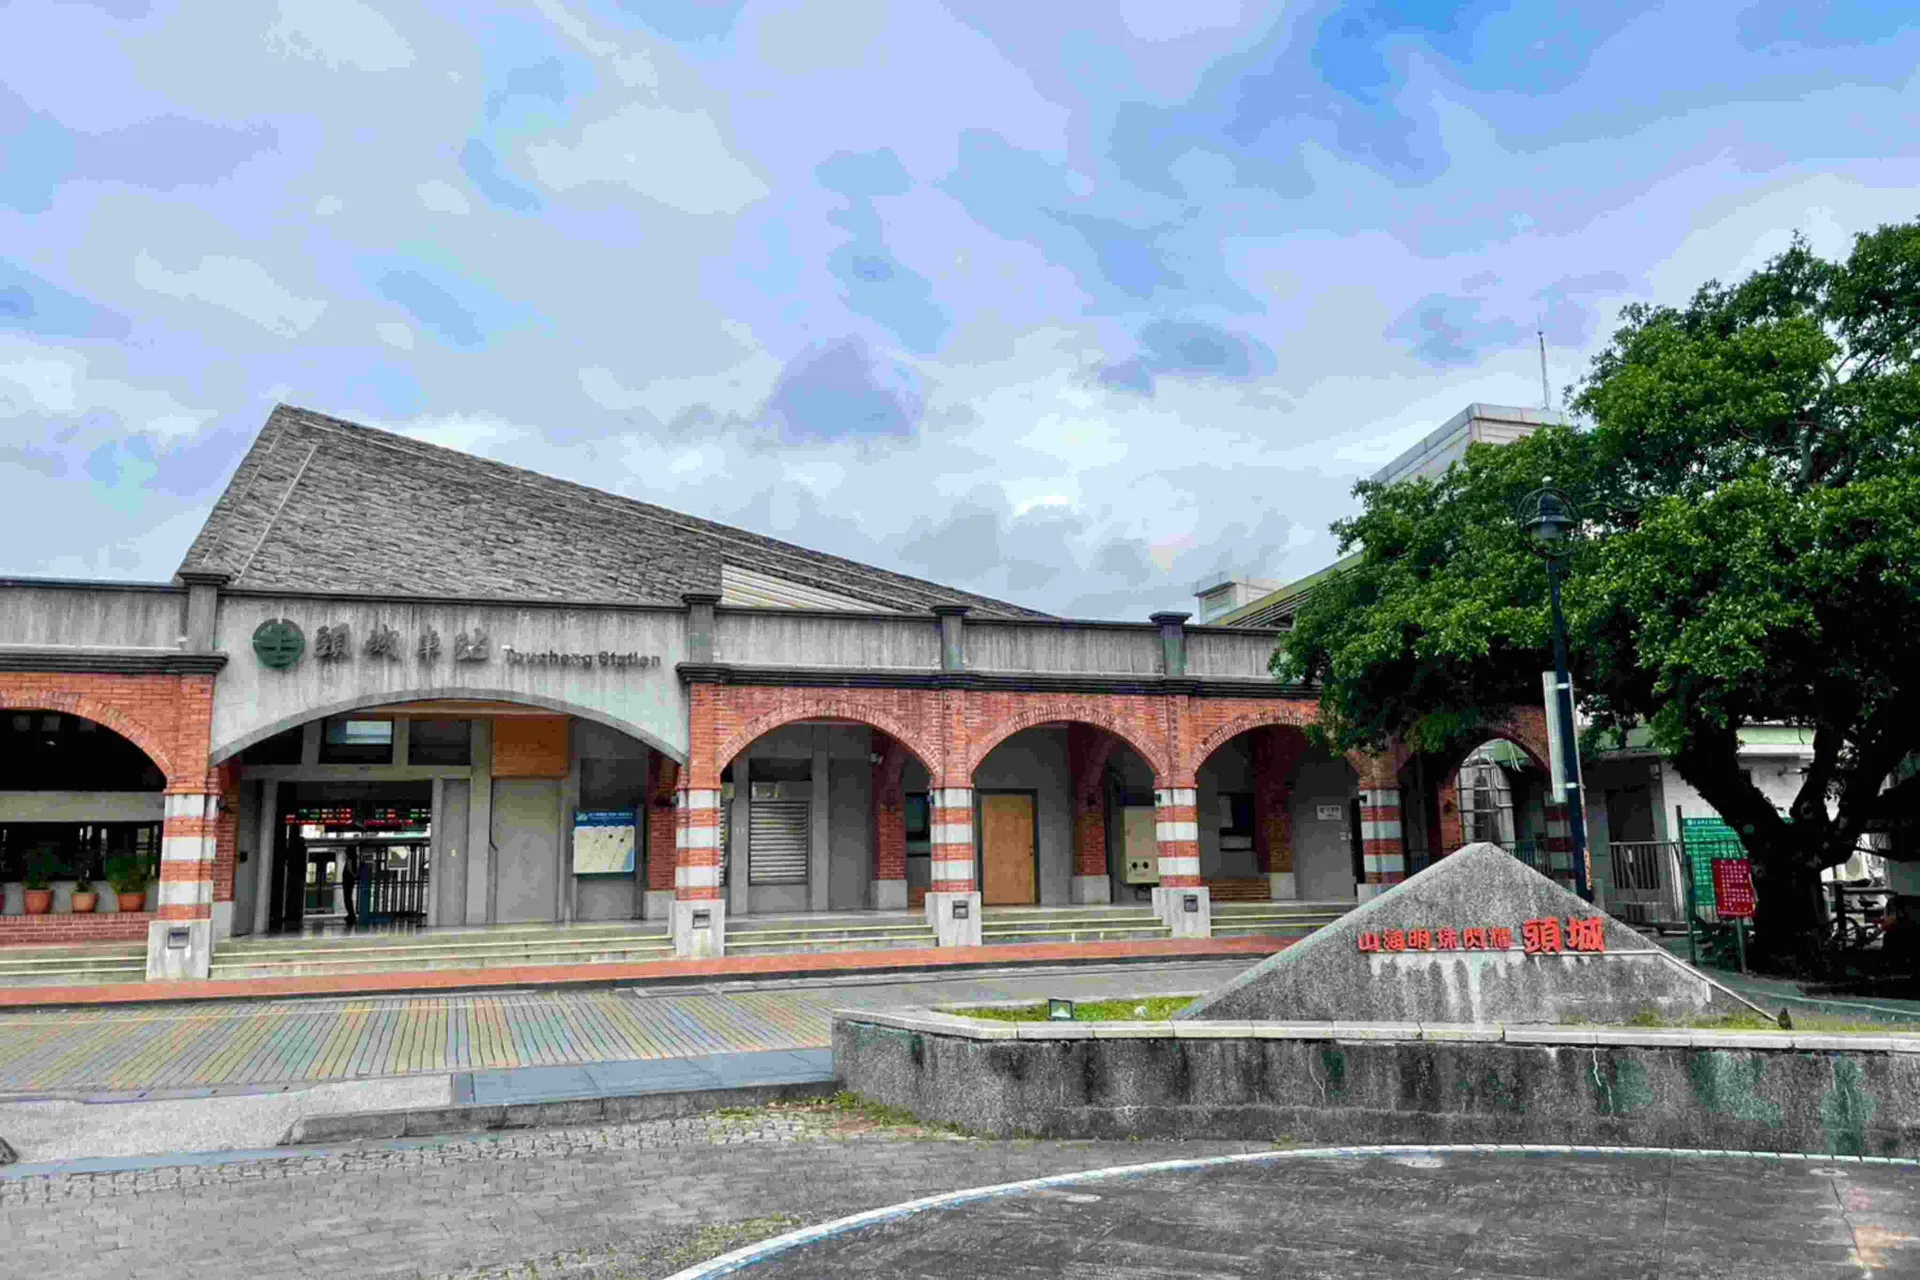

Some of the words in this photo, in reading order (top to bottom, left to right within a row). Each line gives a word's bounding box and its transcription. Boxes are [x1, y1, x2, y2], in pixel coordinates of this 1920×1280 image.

[313, 622, 489, 662] 頭城車站
[504, 648, 592, 669] Toucheng
[599, 651, 661, 668] Station
[1358, 927, 1512, 952] 山海明珠閃耀
[1524, 916, 1607, 954] 頭城
